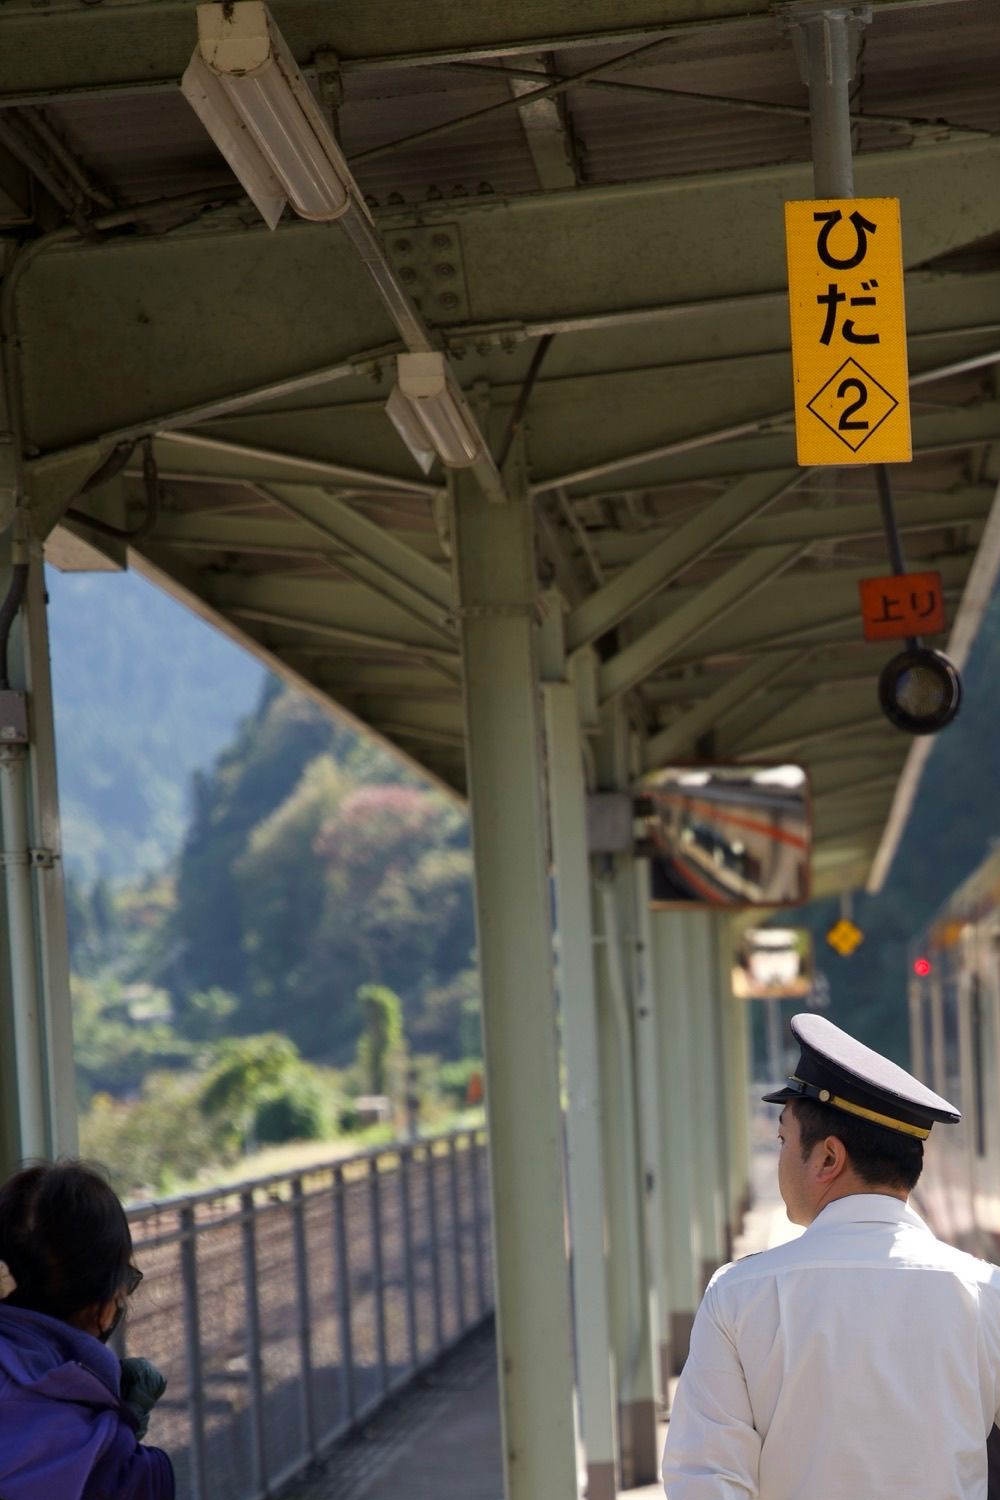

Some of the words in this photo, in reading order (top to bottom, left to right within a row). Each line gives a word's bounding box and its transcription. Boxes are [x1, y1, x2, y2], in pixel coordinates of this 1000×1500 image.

[813, 209, 880, 345] ひだ
[836, 378, 869, 430] 2
[872, 591, 936, 623] 上り
